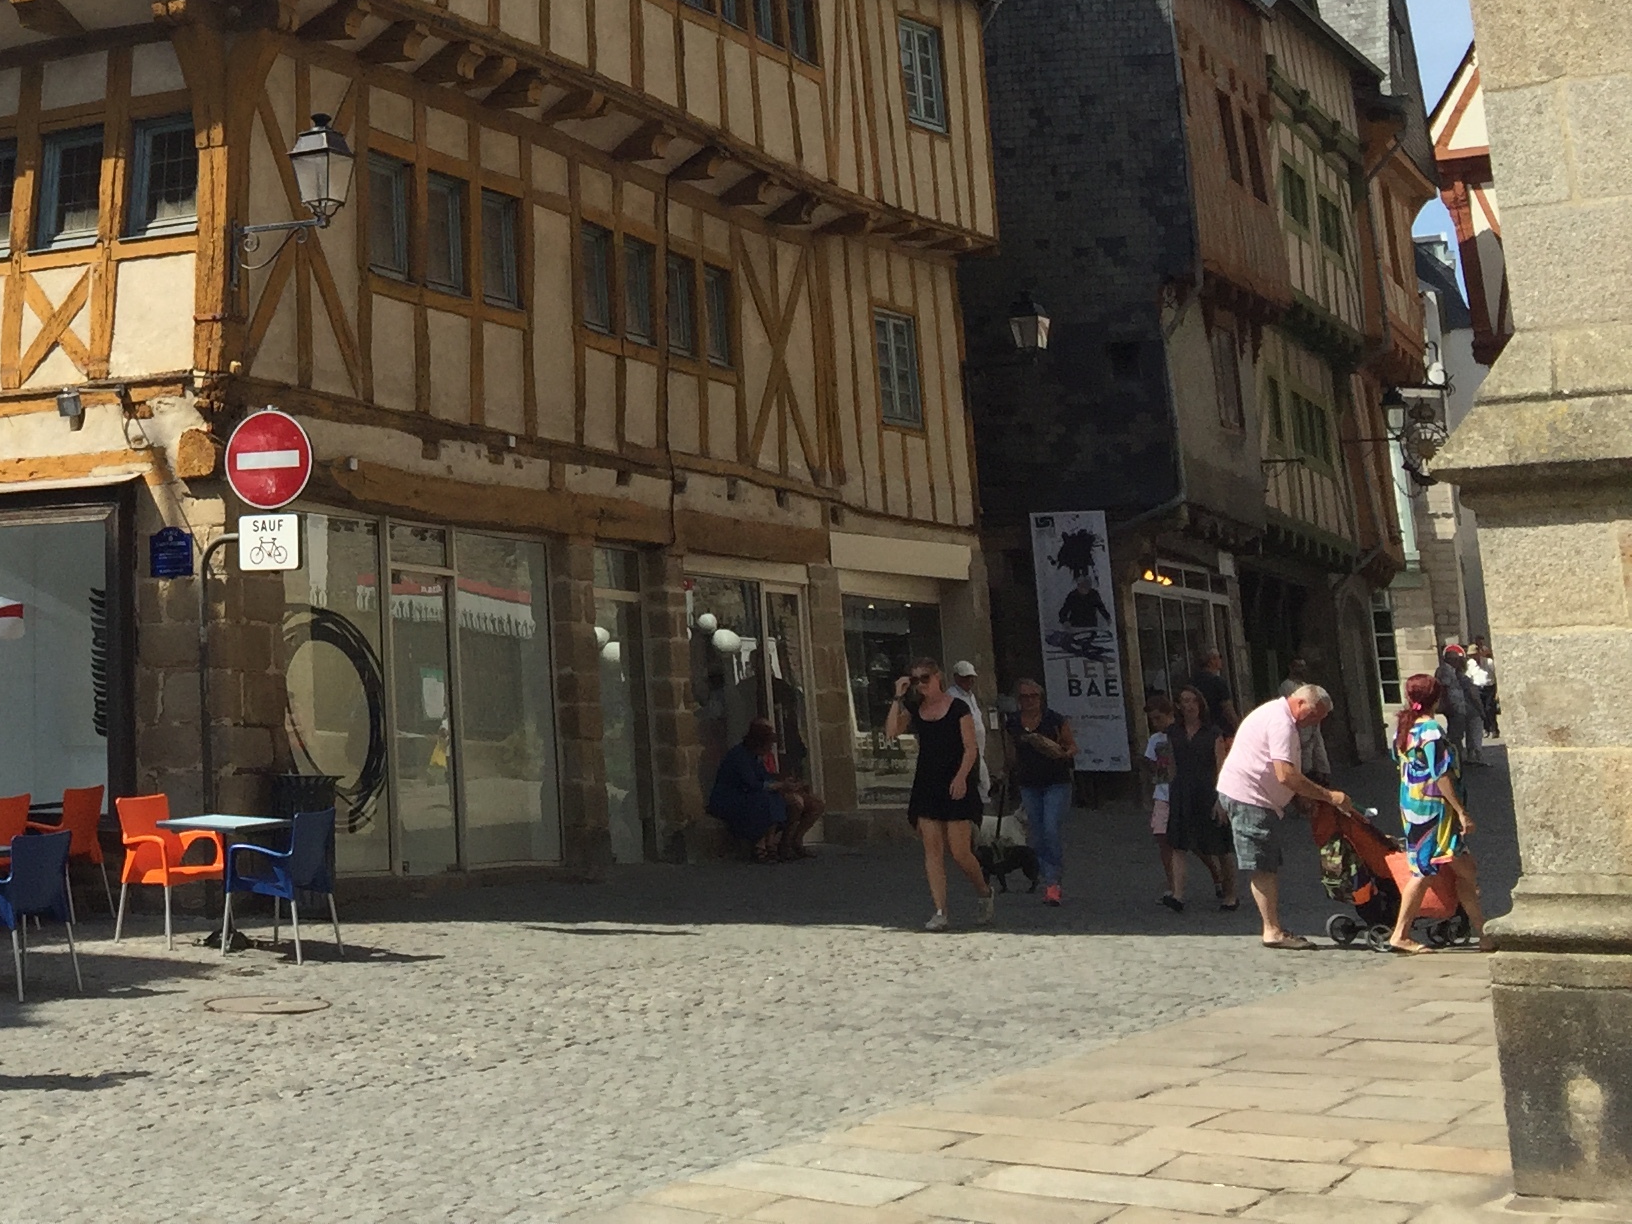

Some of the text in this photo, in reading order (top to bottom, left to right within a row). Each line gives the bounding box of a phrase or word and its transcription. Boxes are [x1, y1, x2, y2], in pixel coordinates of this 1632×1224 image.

[252, 519, 283, 532] SAUF
[1065, 659, 1118, 678] LEE
[1068, 678, 1120, 697] BAE
